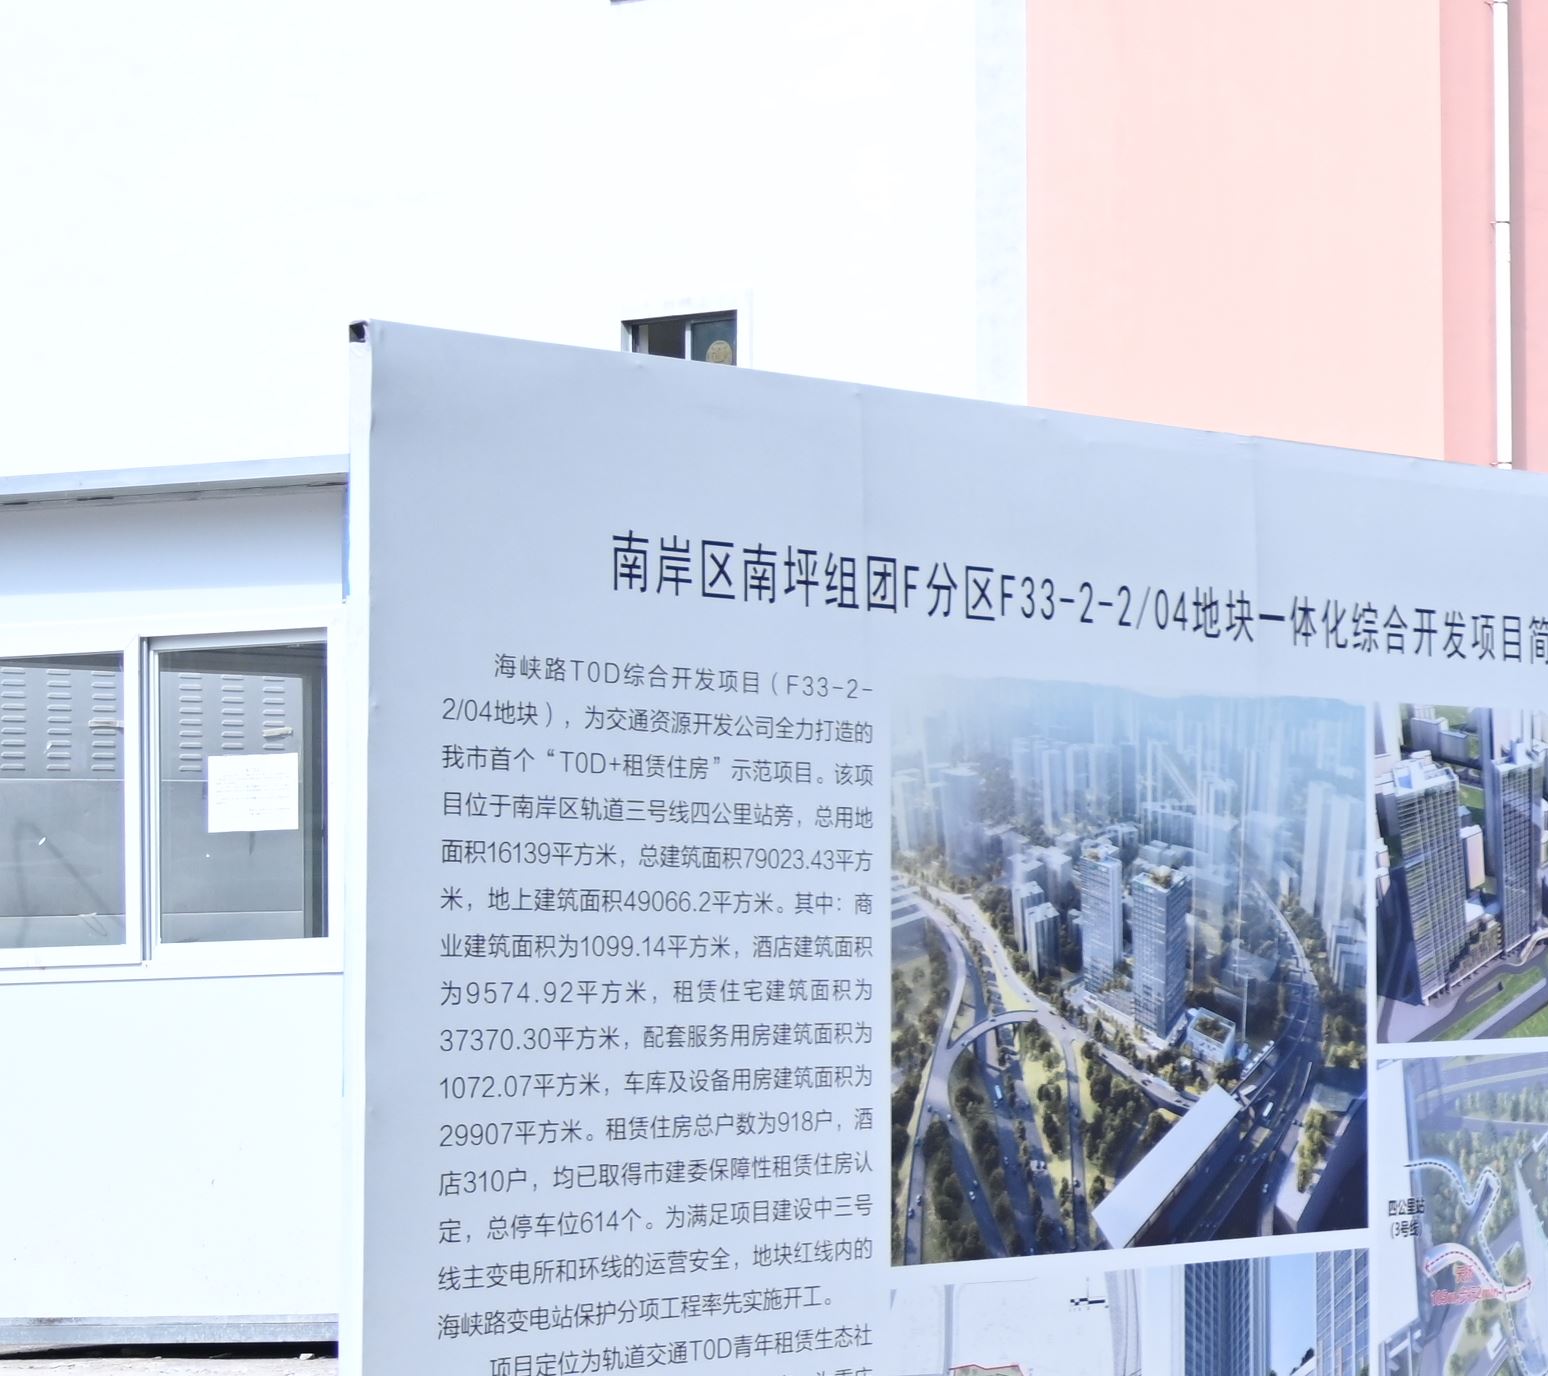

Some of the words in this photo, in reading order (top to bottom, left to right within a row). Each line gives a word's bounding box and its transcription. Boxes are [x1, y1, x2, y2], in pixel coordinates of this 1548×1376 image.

[441, 792, 873, 830] 目位于南岸区轨道三号线四公里站旁，总用地
[441, 838, 873, 874] 面积16139平方米，总建筑面积79023.43平方
[440, 933, 873, 959] 业建筑面积为1099.14平方米，酒店建筑面积
[440, 978, 873, 1006] 为9574.92平方米，租赁住宅建筑面积为
[439, 1021, 873, 1052] 37370.30平方米，配套服务用房建筑面积为
[439, 1064, 873, 1100] 1072.07平方米，车库及设备用房建筑面积为
[439, 1106, 873, 1149] 29907平方米。租赁住房总户数为918户，酒
[438, 1151, 873, 1196] 店310户，均已取得市建委保障性租赁住房认
[439, 1194, 873, 1244] 定，总停车位614个。为满足项目建设中三号
[438, 1238, 873, 1291] 线主变电所和环线的运营安全，地块红线内的
[437, 1285, 833, 1341] 海峡路变电站保护分项工程率先实施开工。
